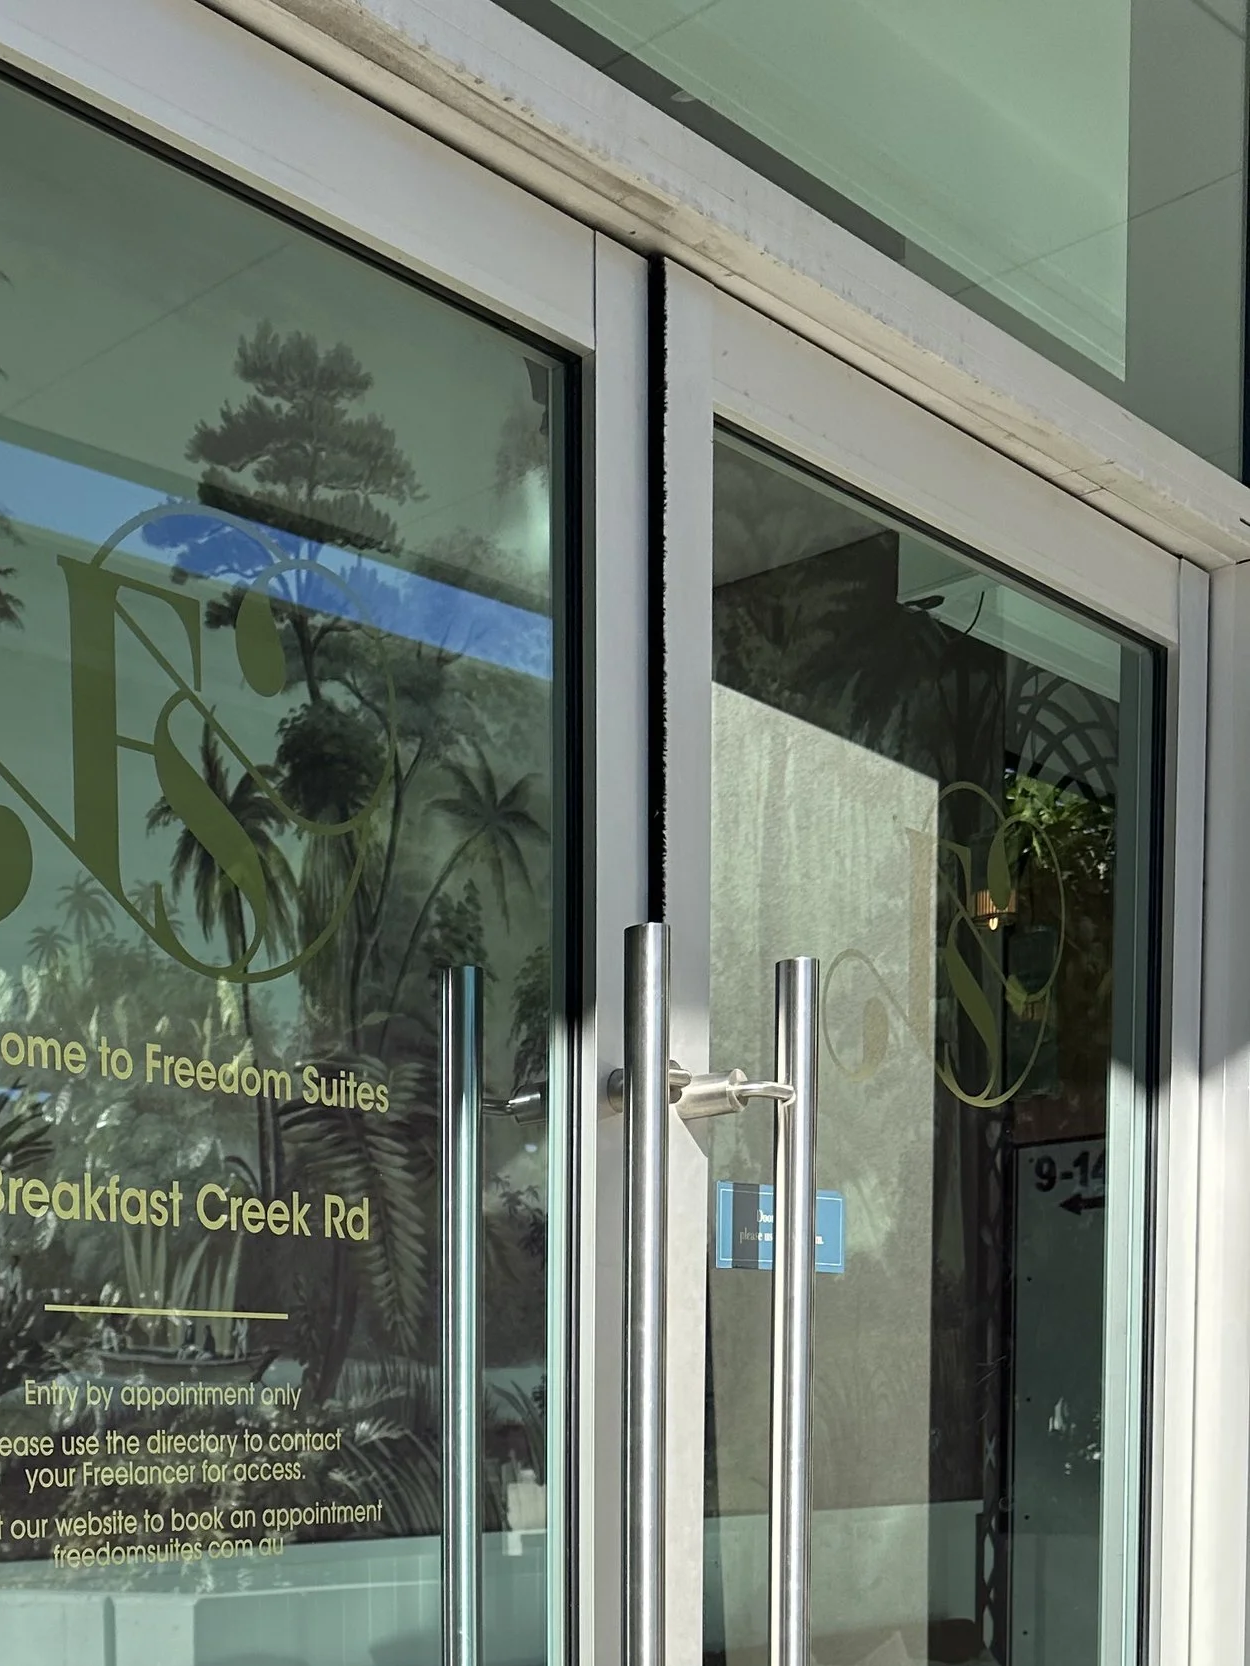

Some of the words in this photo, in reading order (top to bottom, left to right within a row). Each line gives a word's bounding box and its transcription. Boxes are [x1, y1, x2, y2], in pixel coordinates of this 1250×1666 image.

[97, 1036, 133, 1080] to
[145, 1043, 292, 1101] Freedom
[302, 1065, 390, 1113] Suites
[196, 1183, 311, 1237] Creek
[324, 1193, 371, 1241] Rd
[24, 1380, 80, 1410] Entry
[86, 1379, 114, 1411] by
[120, 1381, 255, 1411] appointment
[261, 1383, 302, 1411] only
[61, 1436, 100, 1456] use
[105, 1430, 140, 1455] the
[146, 1429, 238, 1459] directory
[243, 1430, 263, 1453] to
[268, 1428, 342, 1452] contact
[24, 1465, 76, 1493] your
[82, 1461, 196, 1487] Freelancer
[201, 1459, 229, 1483] for
[234, 1461, 306, 1483] access.
[10, 1518, 48, 1541] our
[55, 1510, 137, 1538] website
[143, 1509, 165, 1535] to
[171, 1505, 225, 1534] book
[230, 1508, 257, 1530] an
[262, 1498, 383, 1533] appointment
